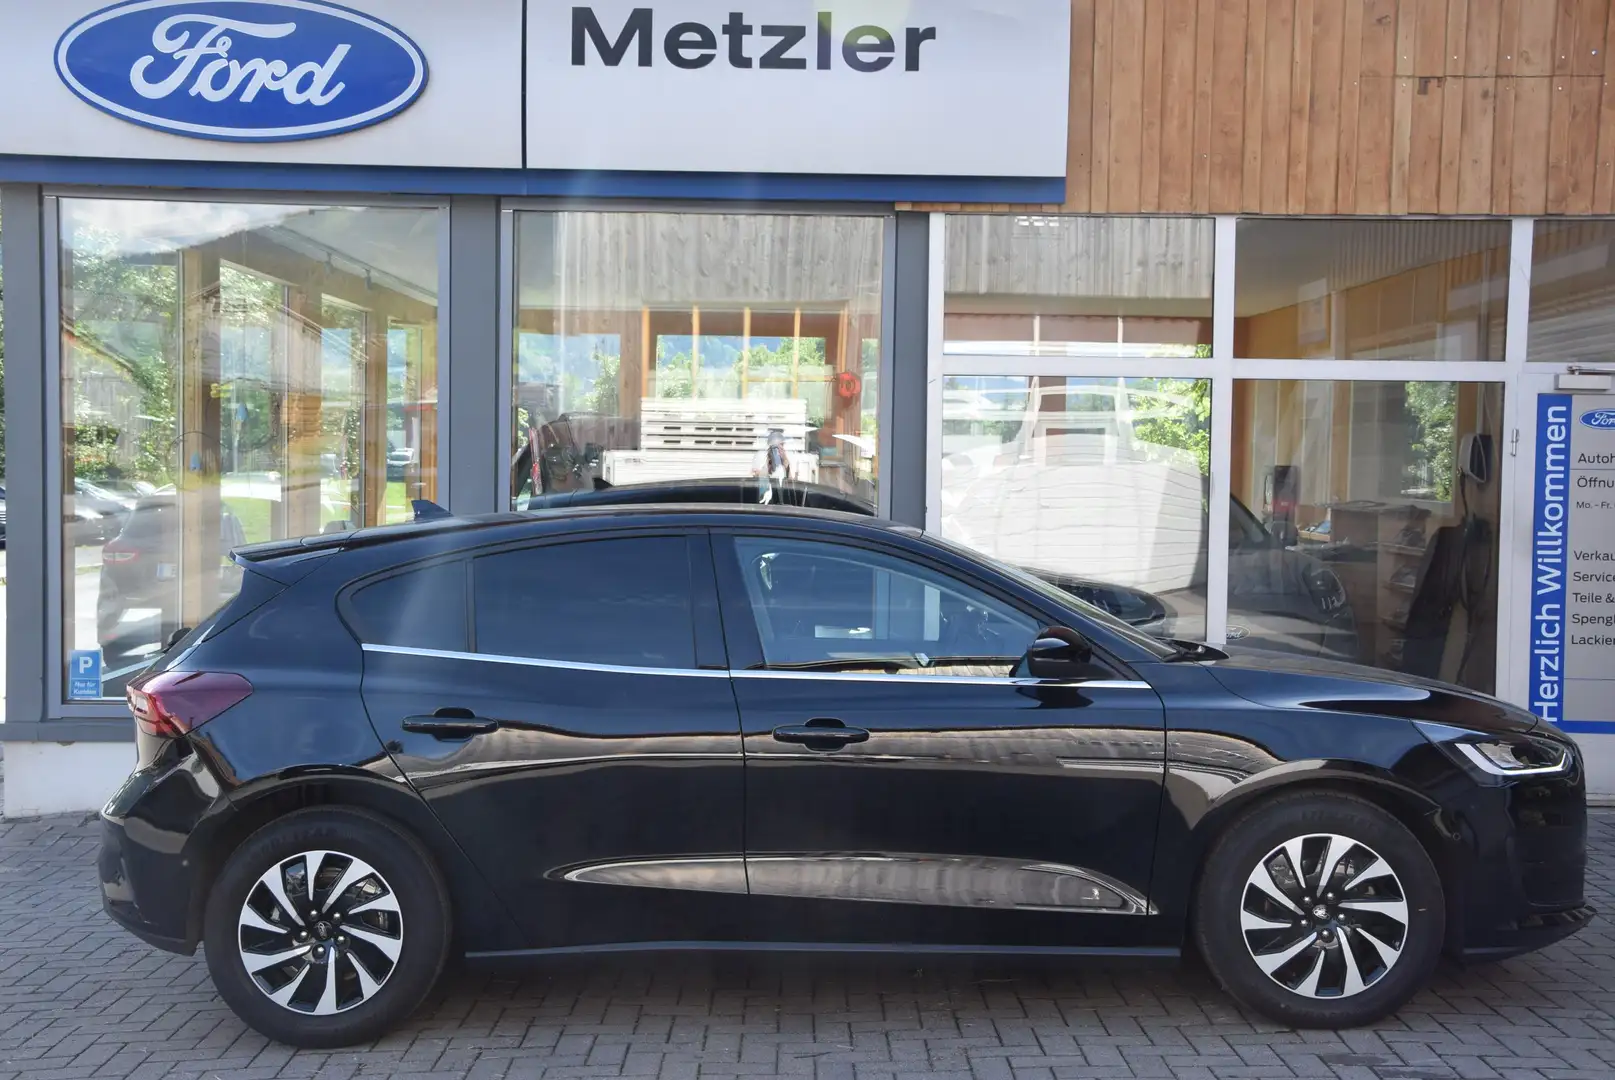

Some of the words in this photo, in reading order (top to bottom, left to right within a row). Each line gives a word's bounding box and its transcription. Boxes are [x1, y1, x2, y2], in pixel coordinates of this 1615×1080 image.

[129, 13, 352, 106] Ford
[571, 6, 936, 73] Metzler
[1536, 405, 1567, 596] Willkommen
[1577, 475, 1615, 489] Öffnu
[1576, 501, 1593, 509] Mo.
[1600, 501, 1613, 509] Fr.
[1572, 592, 1602, 603] Teile
[1605, 592, 1615, 603] &
[79, 656, 93, 674] P
[1534, 603, 1561, 722] Herzlich
